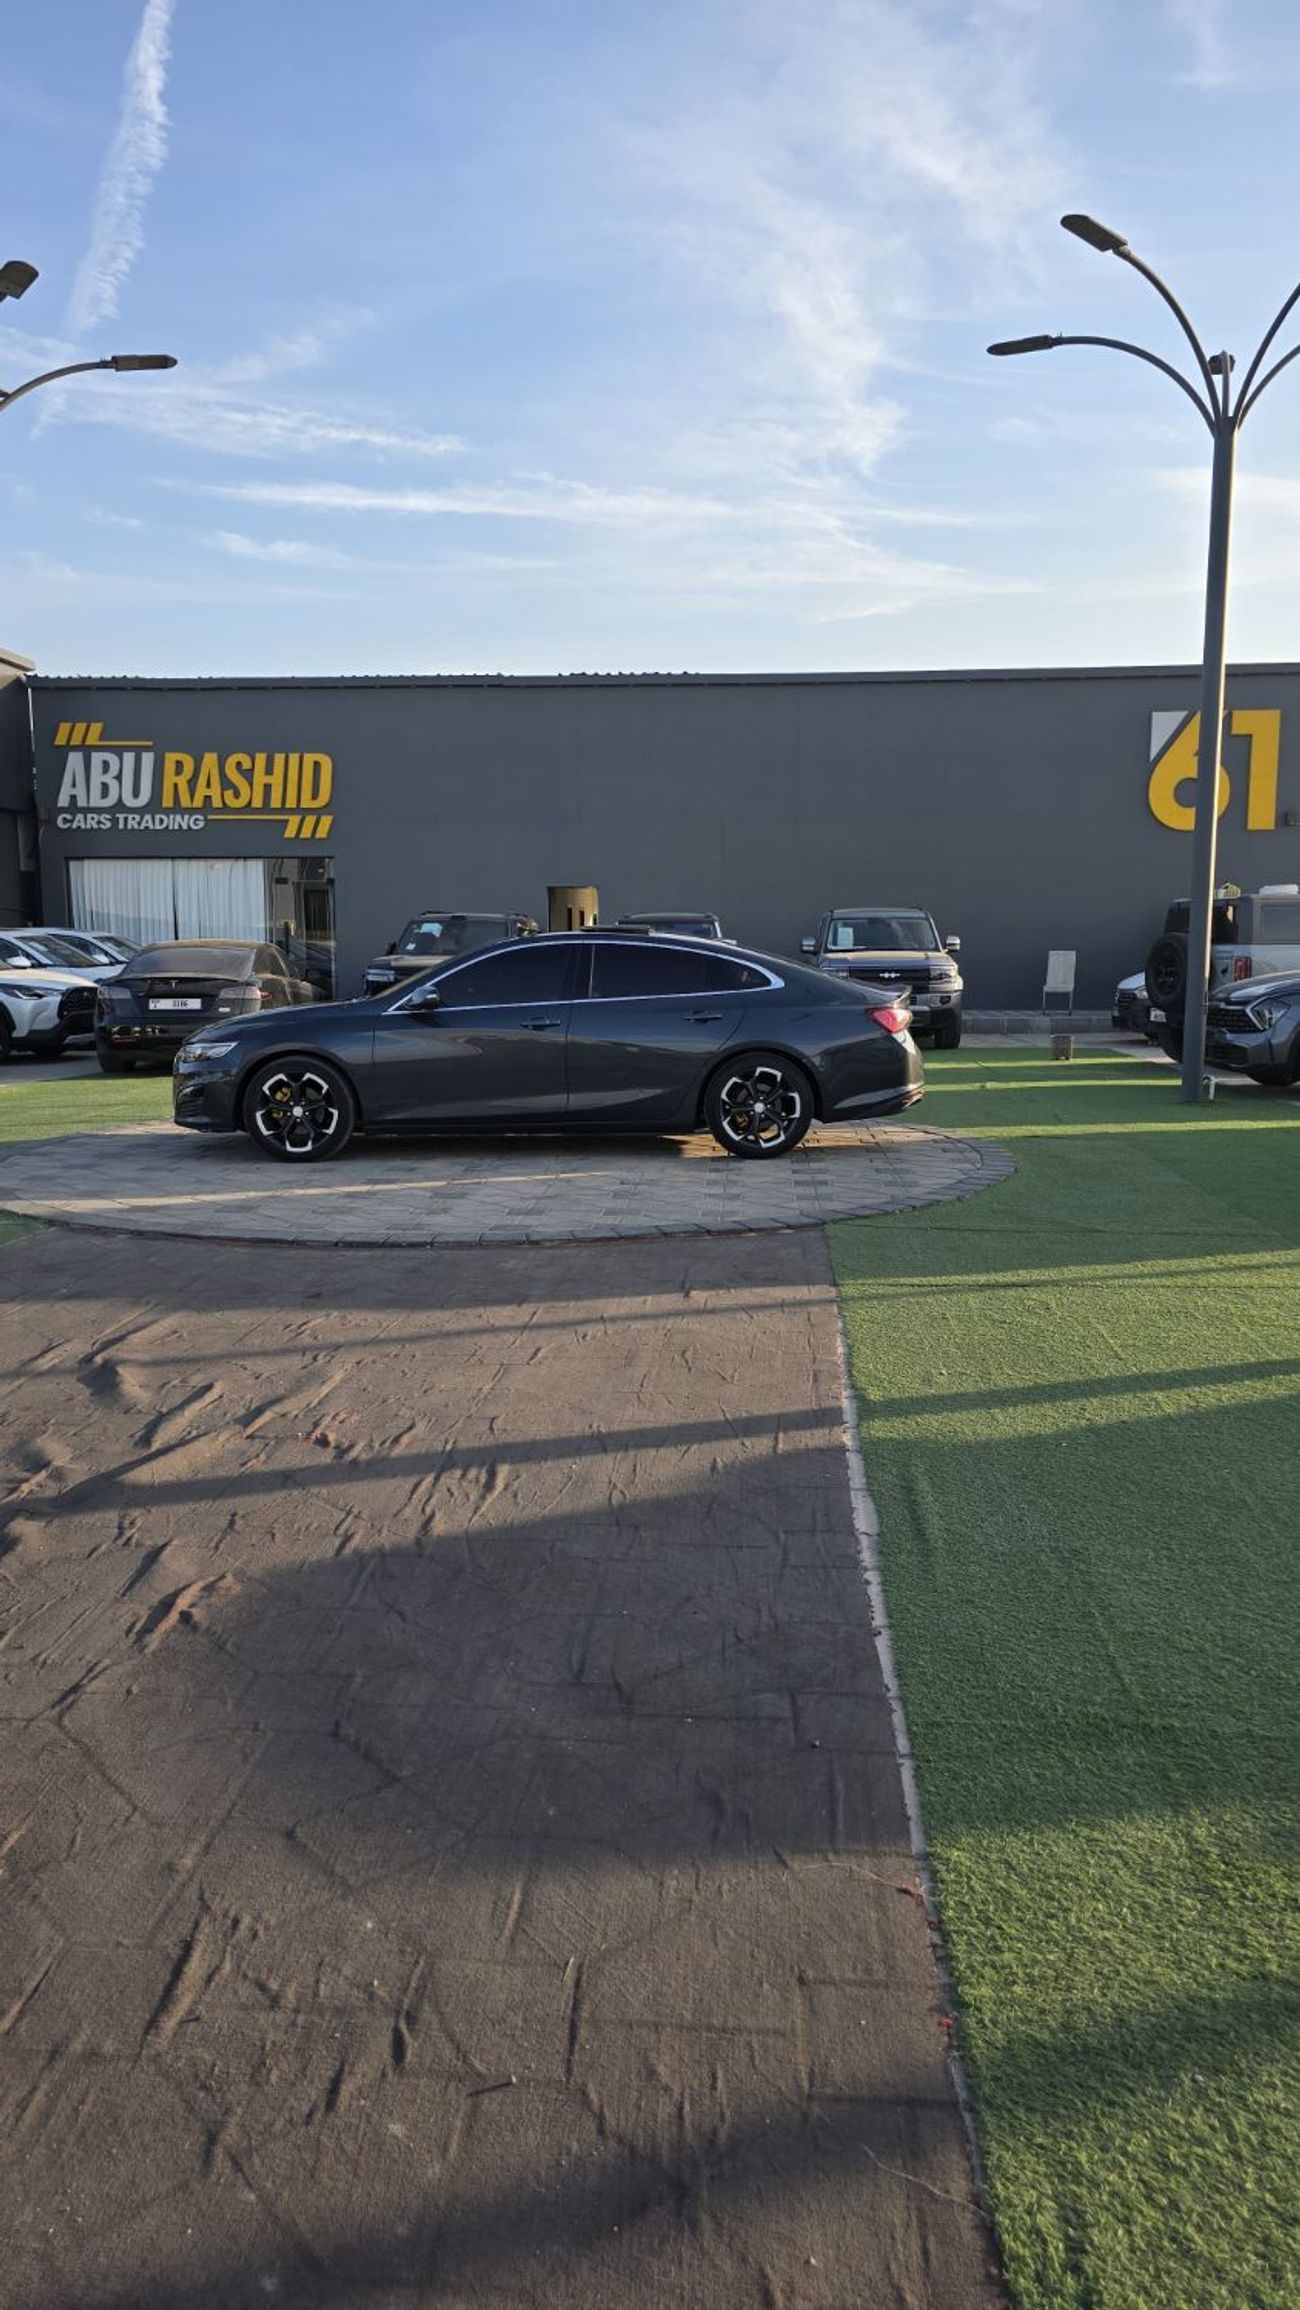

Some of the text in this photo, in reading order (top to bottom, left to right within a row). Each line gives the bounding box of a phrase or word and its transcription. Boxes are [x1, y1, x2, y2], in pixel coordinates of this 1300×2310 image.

[57, 751, 333, 809] ABU RASHID
[1148, 709, 1281, 831] 61
[57, 813, 205, 830] CARS TRADING
